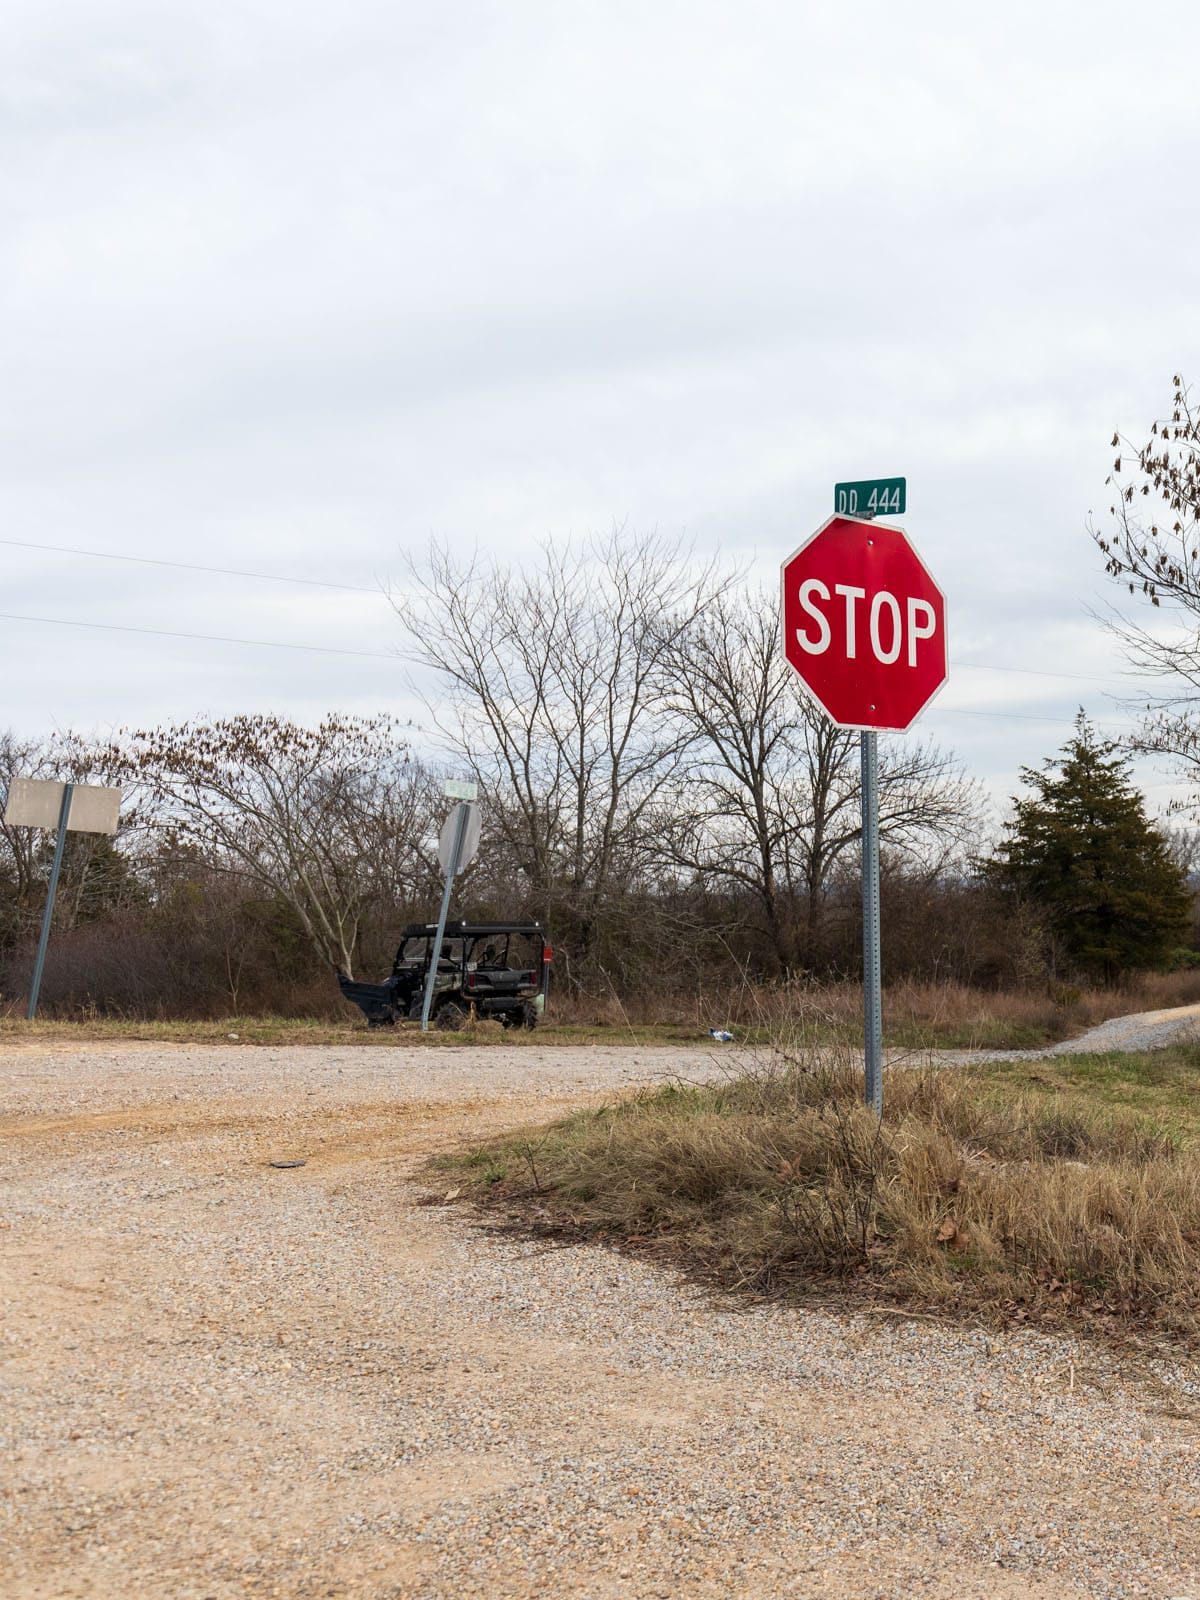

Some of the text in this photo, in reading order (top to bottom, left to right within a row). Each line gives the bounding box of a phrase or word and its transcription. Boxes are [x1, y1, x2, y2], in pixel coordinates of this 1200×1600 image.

[839, 487, 900, 513] DD 444
[796, 578, 936, 667] STOP
